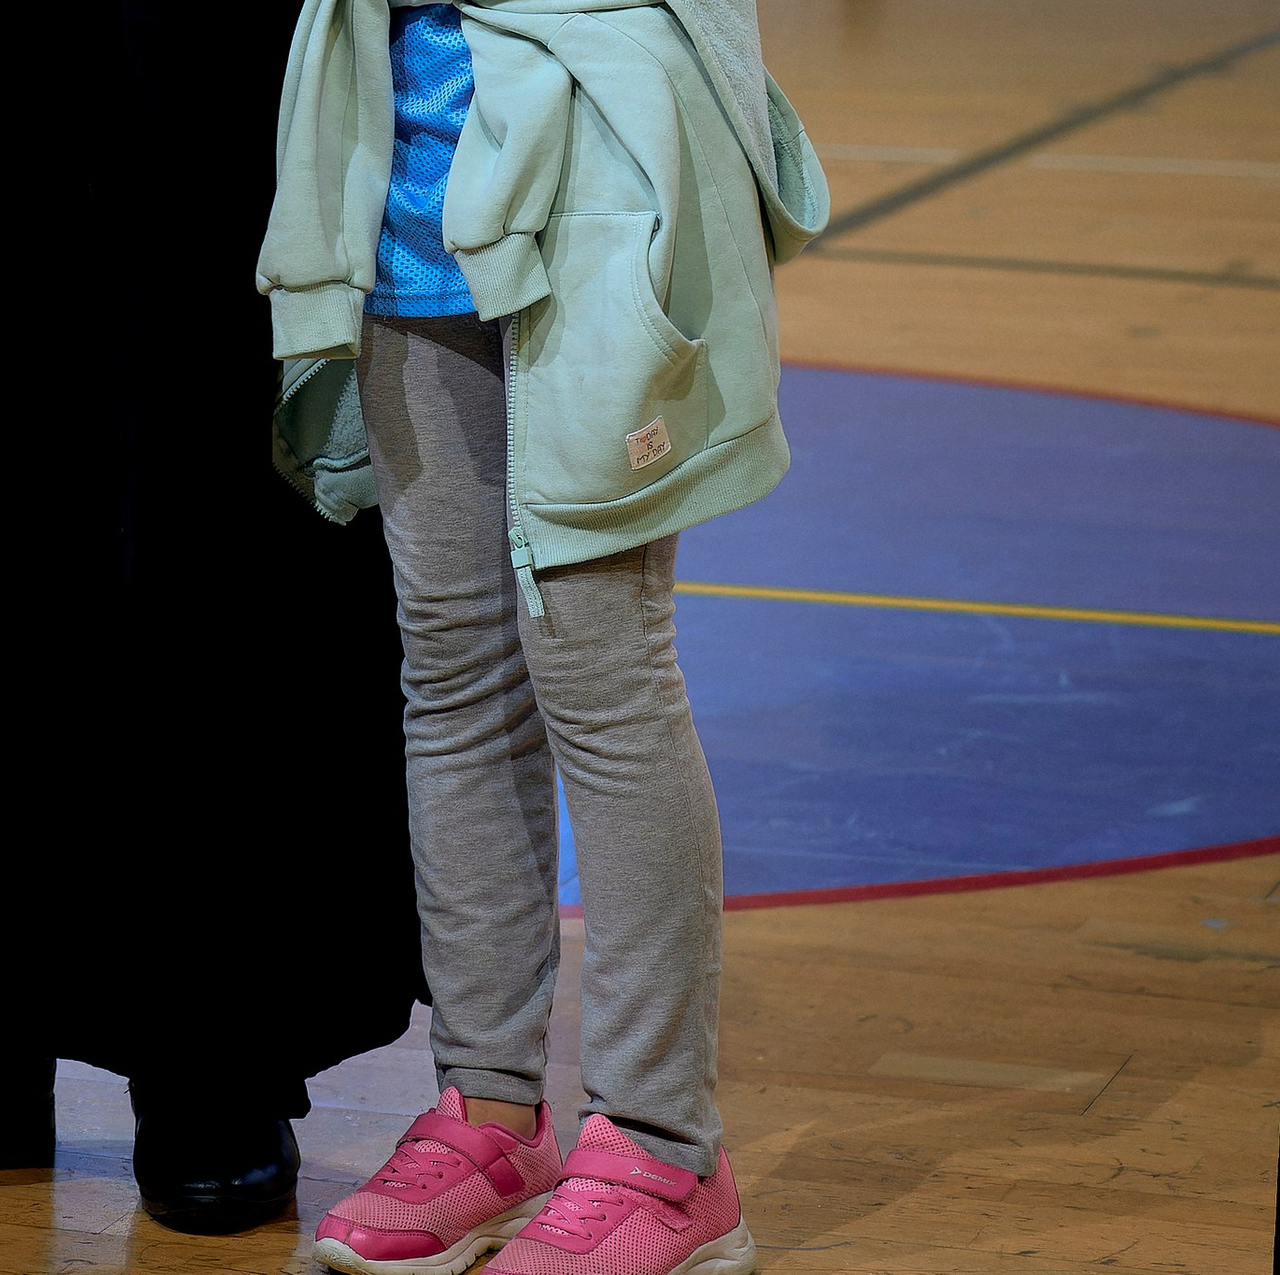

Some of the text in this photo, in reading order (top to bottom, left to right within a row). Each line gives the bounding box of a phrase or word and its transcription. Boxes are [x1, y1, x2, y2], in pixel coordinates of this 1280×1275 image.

[636, 441, 666, 465] MY DAY
[646, 441, 654, 451] IS
[642, 1171, 677, 1186] DEMIX
